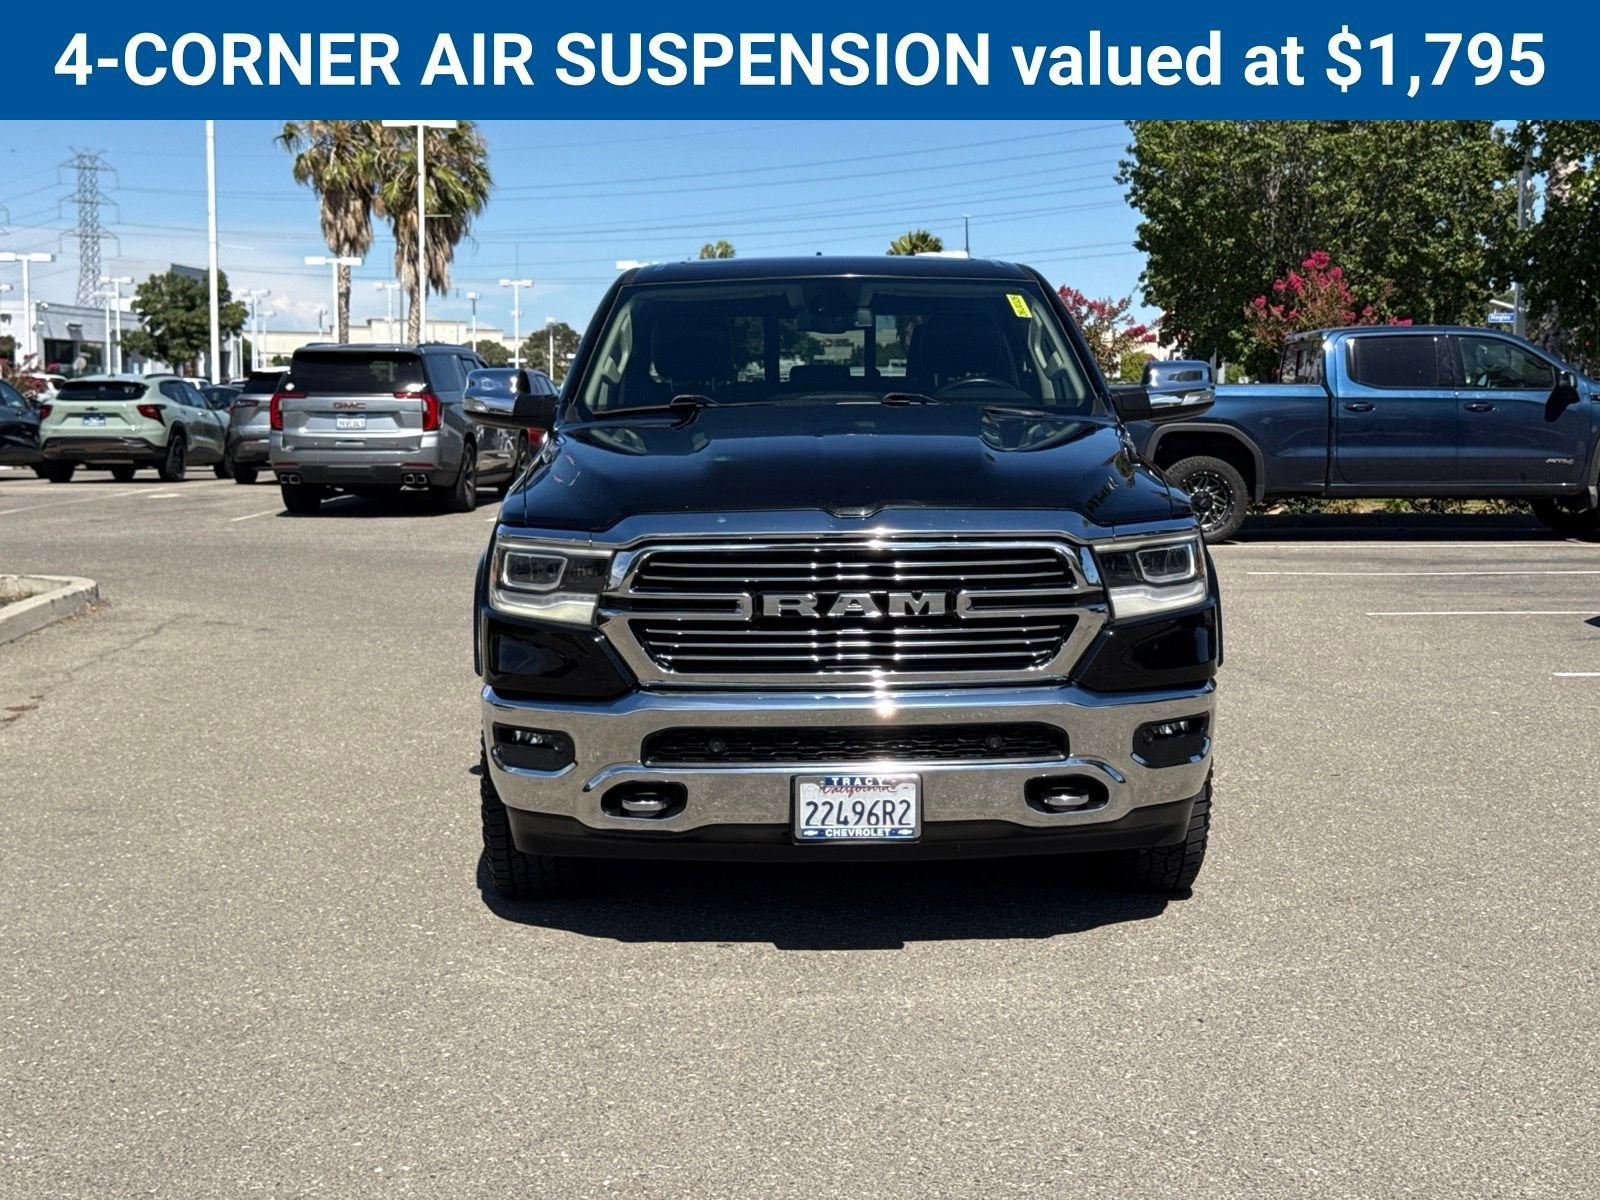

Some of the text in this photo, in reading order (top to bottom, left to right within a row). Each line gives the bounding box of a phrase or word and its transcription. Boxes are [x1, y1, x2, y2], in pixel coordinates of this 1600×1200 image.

[763, 591, 946, 617] RAM
[831, 777, 883, 786] TRACY
[804, 799, 912, 827] 22496R2
[824, 828, 890, 837] CHEVROLET
